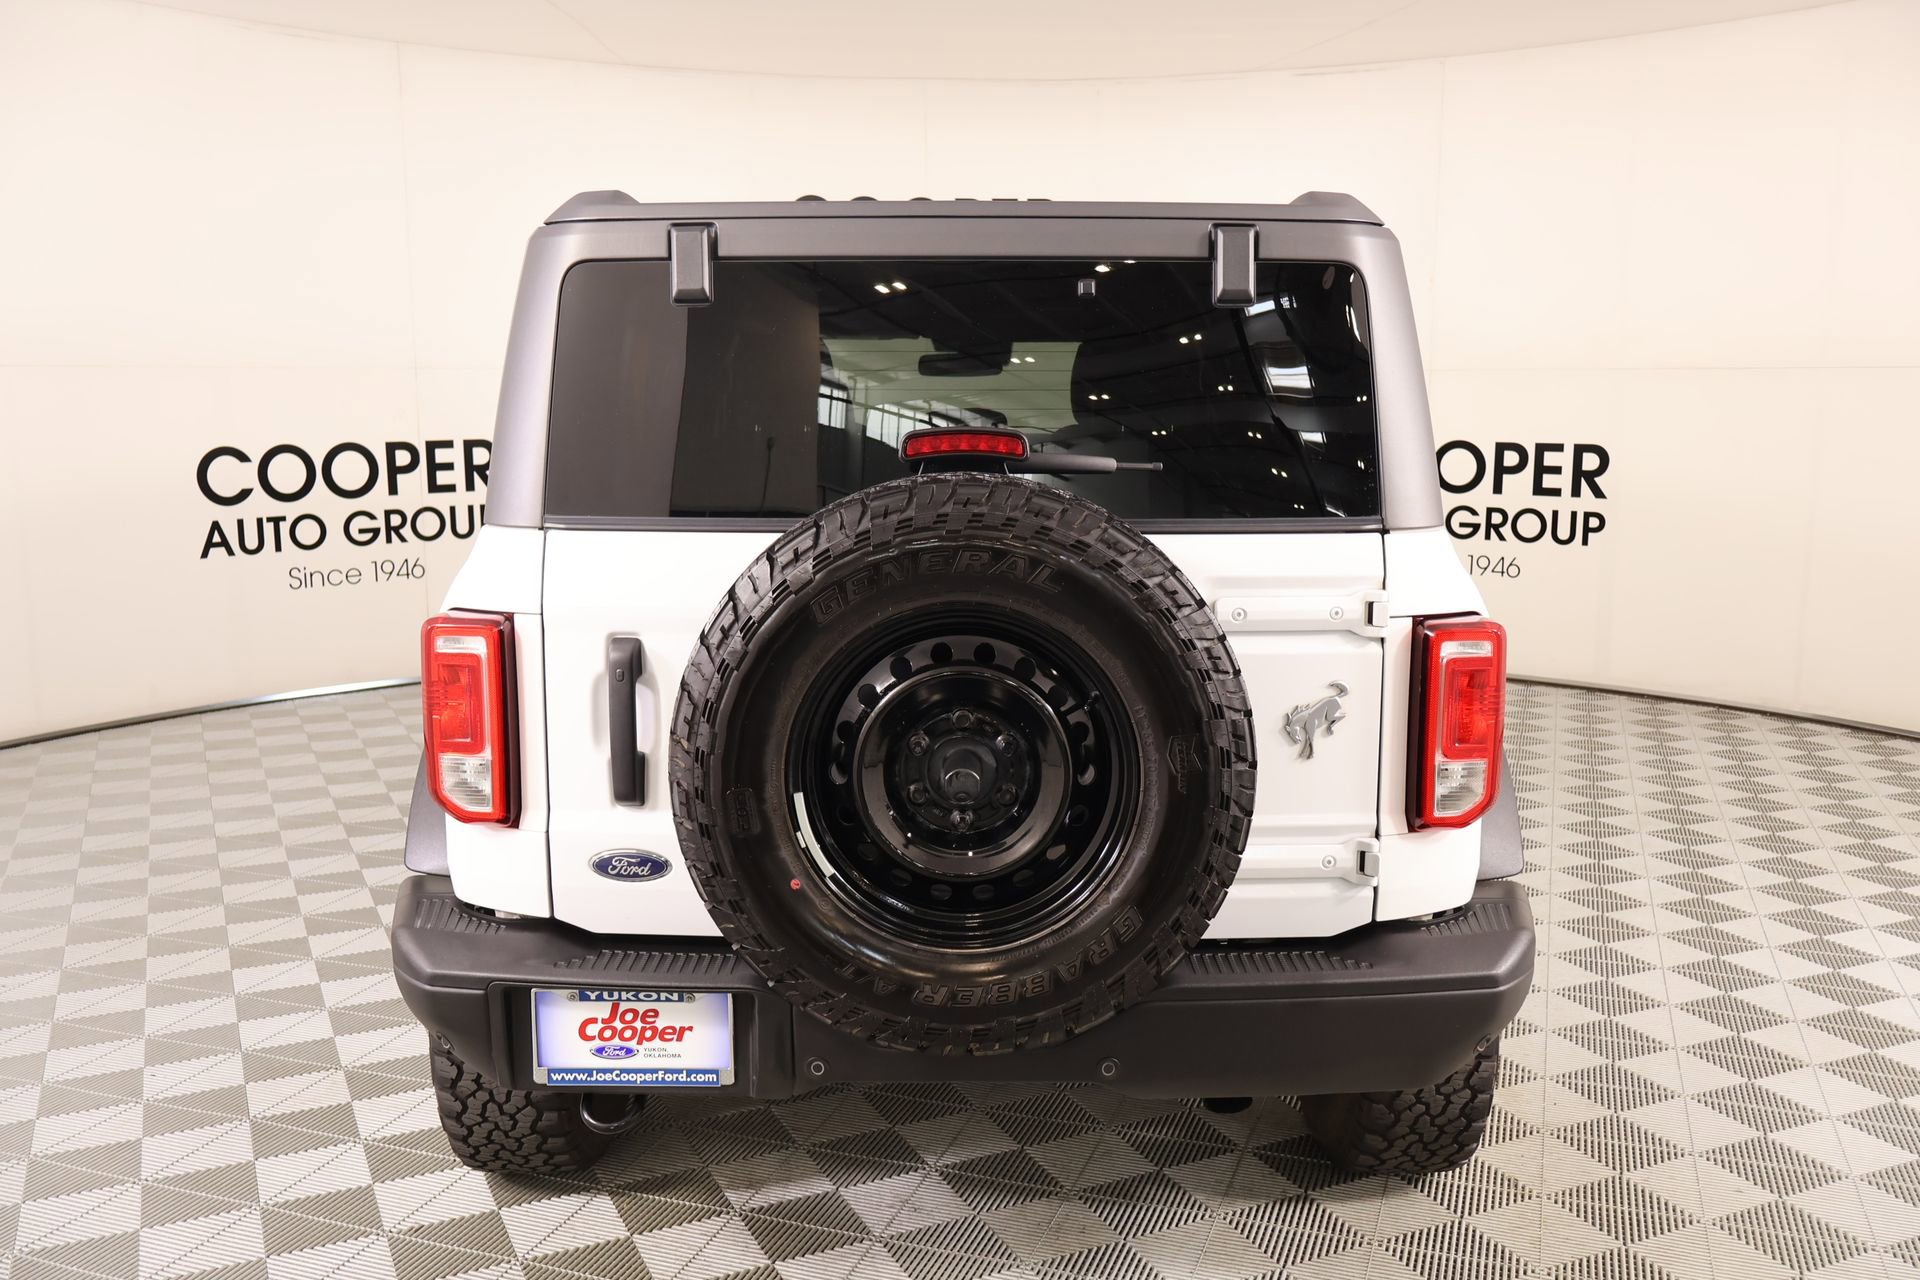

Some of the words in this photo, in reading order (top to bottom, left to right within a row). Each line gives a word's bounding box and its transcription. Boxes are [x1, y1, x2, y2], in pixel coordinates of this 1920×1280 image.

[196, 439, 493, 507] COOPER
[200, 513, 328, 560] AUTO
[343, 504, 486, 547] GROU
[1444, 504, 1607, 547] GROUP
[288, 565, 363, 591] Since
[370, 557, 426, 583] 1946
[1466, 553, 1521, 579] 1946
[809, 549, 1063, 625] GENERAL
[607, 856, 653, 876] Ford
[911, 904, 1144, 1009] GRABBER
[584, 991, 681, 1001] YUKON
[600, 1001, 660, 1026] Joe
[577, 1016, 694, 1046] Cooper
[550, 1069, 717, 1084] www.JoeCooperFord.com
